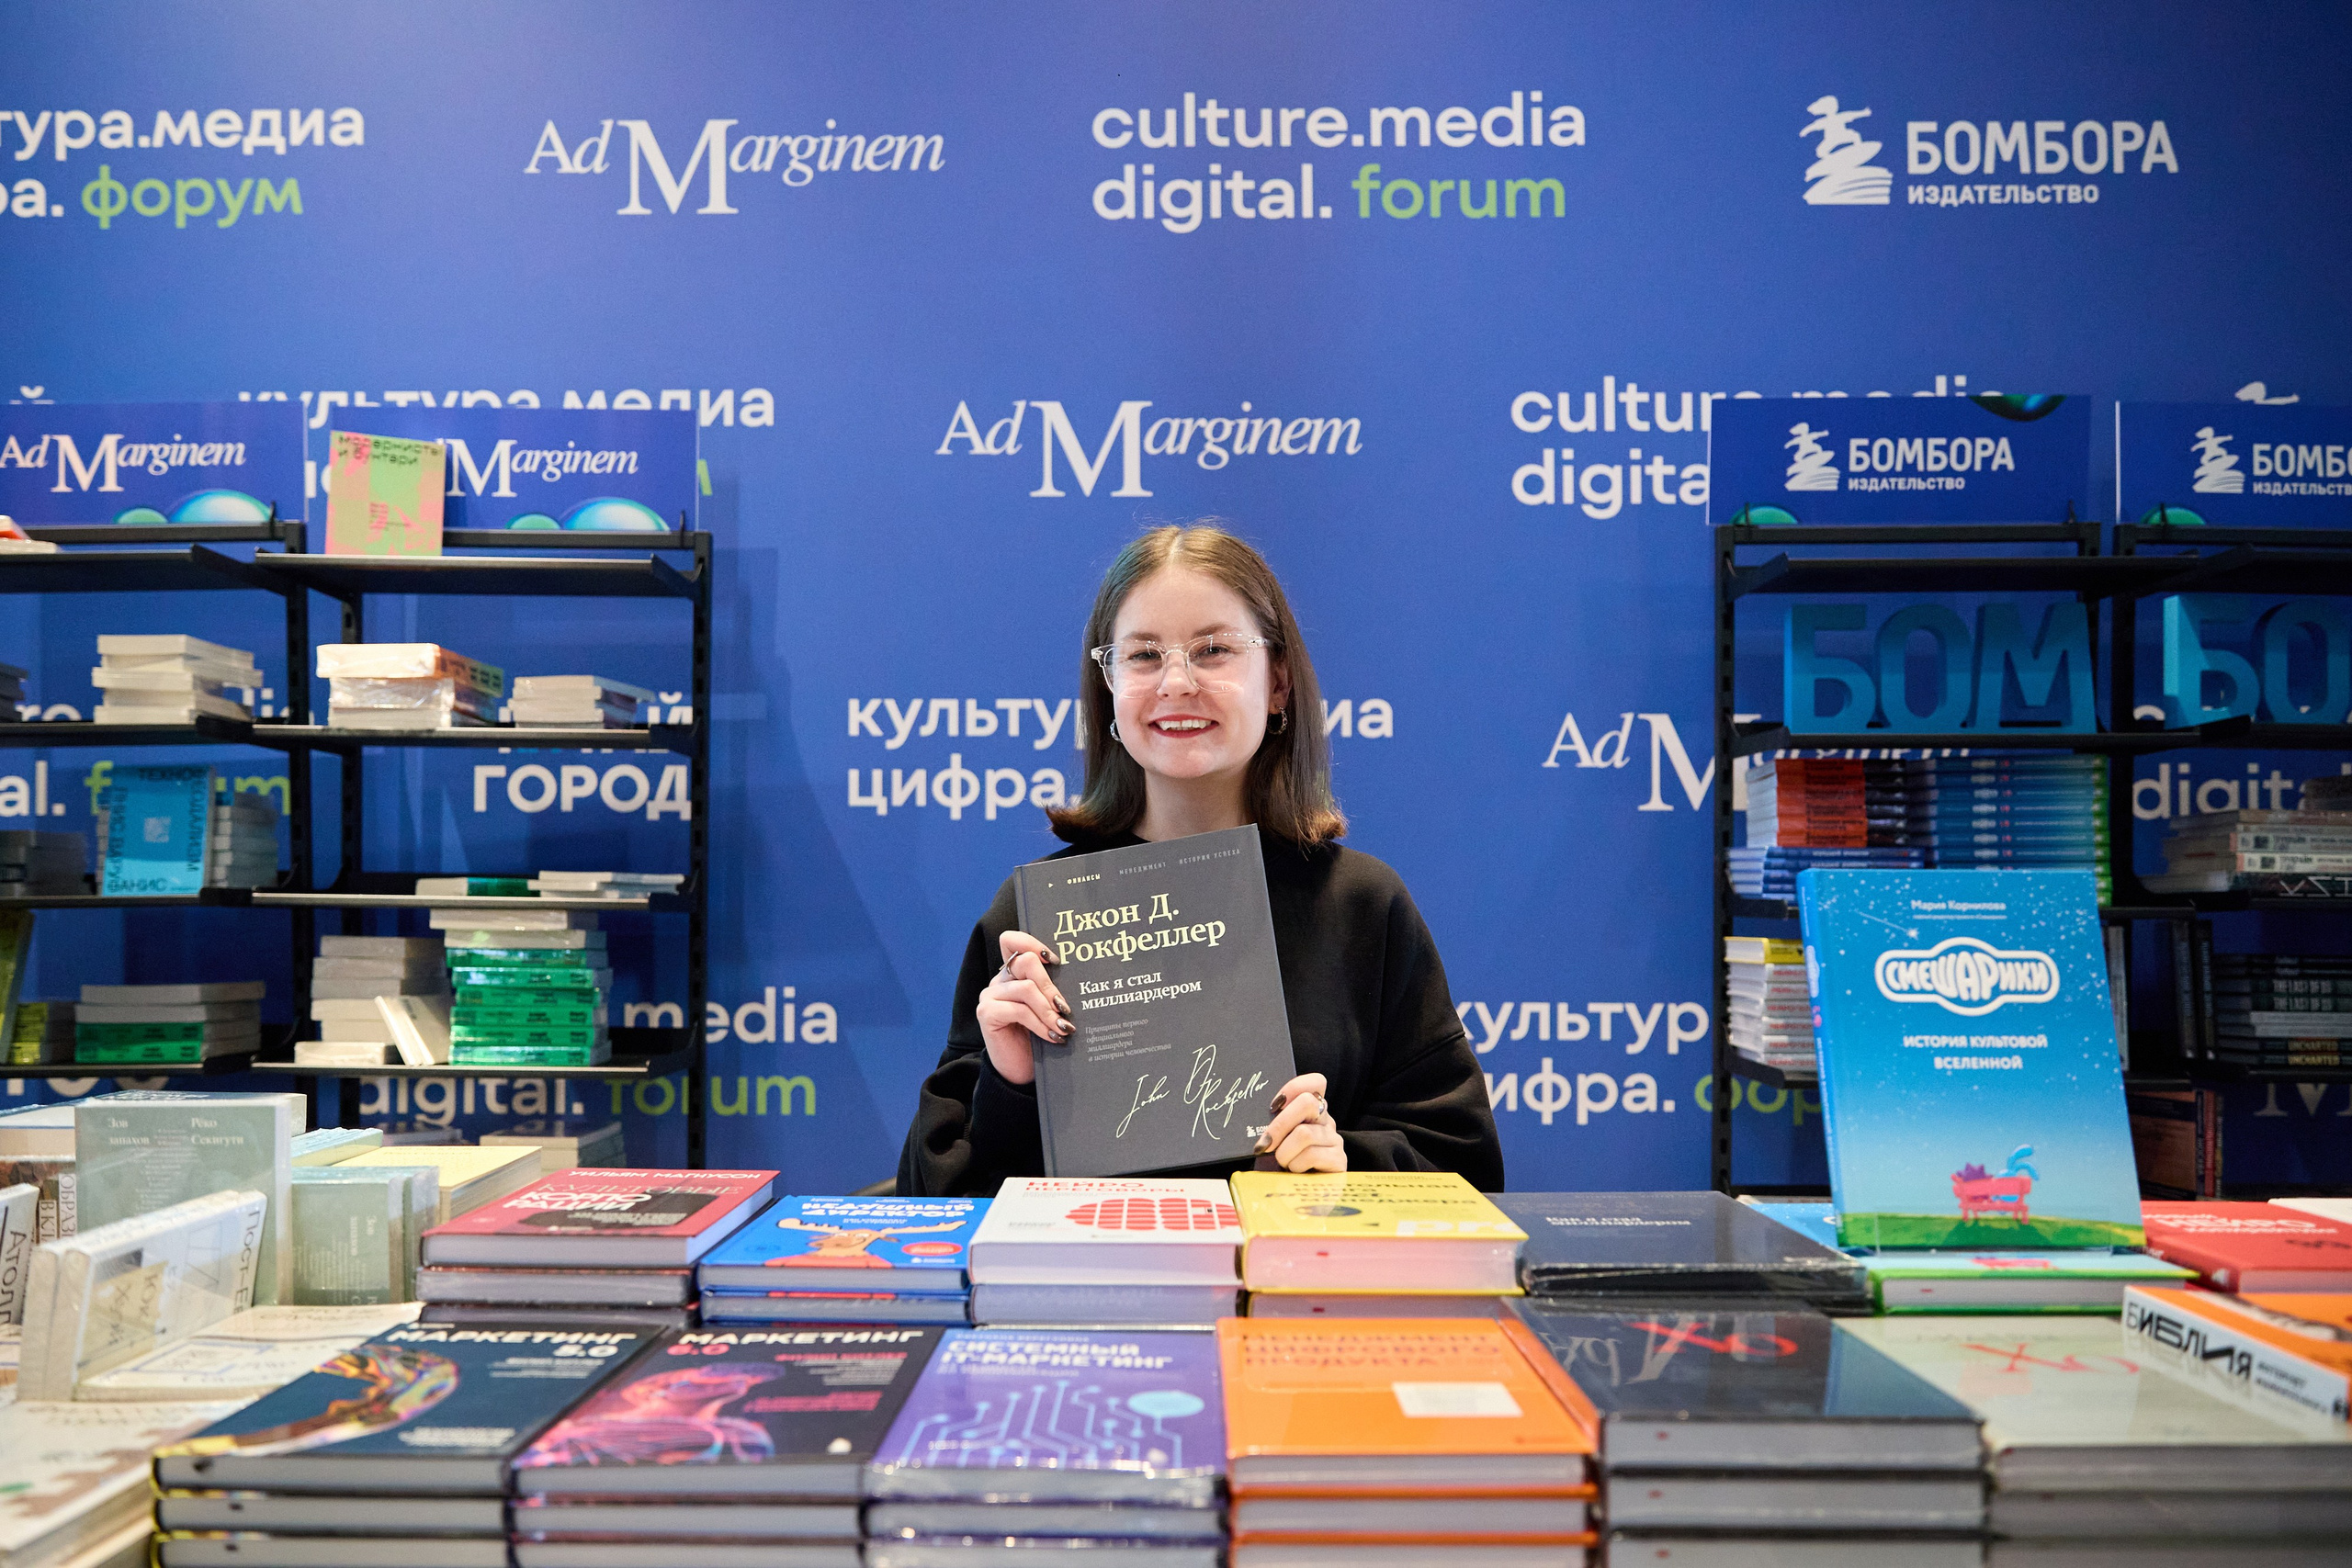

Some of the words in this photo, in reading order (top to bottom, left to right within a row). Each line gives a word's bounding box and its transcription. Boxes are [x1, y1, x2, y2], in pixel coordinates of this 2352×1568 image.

[1091, 90, 1587, 148] culture.media
[523, 118, 614, 175] Ad
[616, 118, 946, 215] Marginem
[1906, 120, 2179, 175] БОМБОРА
[81, 164, 304, 230] форум
[1091, 163, 1333, 233] digital.
[1351, 163, 1566, 220] forum
[1907, 185, 2100, 208] ИЗДАТЕЛЬСТВО
[0, 435, 51, 468] Ad
[51, 433, 246, 493] Marginem
[447, 438, 639, 497] Marginem
[935, 400, 1027, 456] Ad
[1029, 400, 1363, 498] Marginem
[1849, 437, 2016, 471] БОМБОРА
[1510, 448, 1711, 520] digita
[1849, 477, 1966, 492] ИЗДАТЕЛЬСТВО
[1784, 603, 2098, 735] БОМ
[1543, 712, 1634, 768] Ad
[473, 763, 693, 821] ГОРОД
[848, 752, 1080, 820] цифра.
[2132, 763, 2308, 820] digit
[1119, 861, 1168, 875] МЕНЕДЖМЕНТ
[1179, 853, 1211, 865] ИСТОРИЯ
[1213, 848, 1241, 860] УСПЕХА
[1067, 874, 1102, 886] ФИНАНСЫ
[1054, 904, 1142, 941] Джон
[1148, 892, 1181, 924] Д.
[1911, 899, 1946, 912] Мария
[1948, 899, 2007, 912] Корнилова
[1056, 919, 1227, 965] Рокфеллер
[1079, 979, 1111, 996] Как
[1113, 978, 1125, 990] я
[1126, 971, 1163, 987] стал
[1081, 979, 1203, 1011] миллиардером
[1884, 950, 2050, 1002] СМЕШАРИКИ
[1903, 1034, 1968, 1049] ИСТОРИЯ
[1970, 1033, 2048, 1049] КУЛЬТОВОЙ
[1933, 1055, 2024, 1071] ВСЕЛЕННОЙ
[1483, 1057, 1677, 1126] ифра.
[537, 1183, 745, 1195] КУЛЬТОВЫЕ
[569, 1170, 647, 1179] УИЛЬЯМ
[652, 1172, 763, 1180] МАГНУСОН
[1025, 1179, 1146, 1189] НЕЙРО
[519, 1191, 653, 1203] КОРПО
[386, 1329, 639, 1344] МАРКЕТИНГ
[553, 1343, 621, 1359] 5.0
[677, 1330, 924, 1346] МАРКЕТИНГ
[947, 1340, 1140, 1357] СИСТЕМНЫЙ
[2126, 1302, 2254, 1380] БИБЛИЯ
